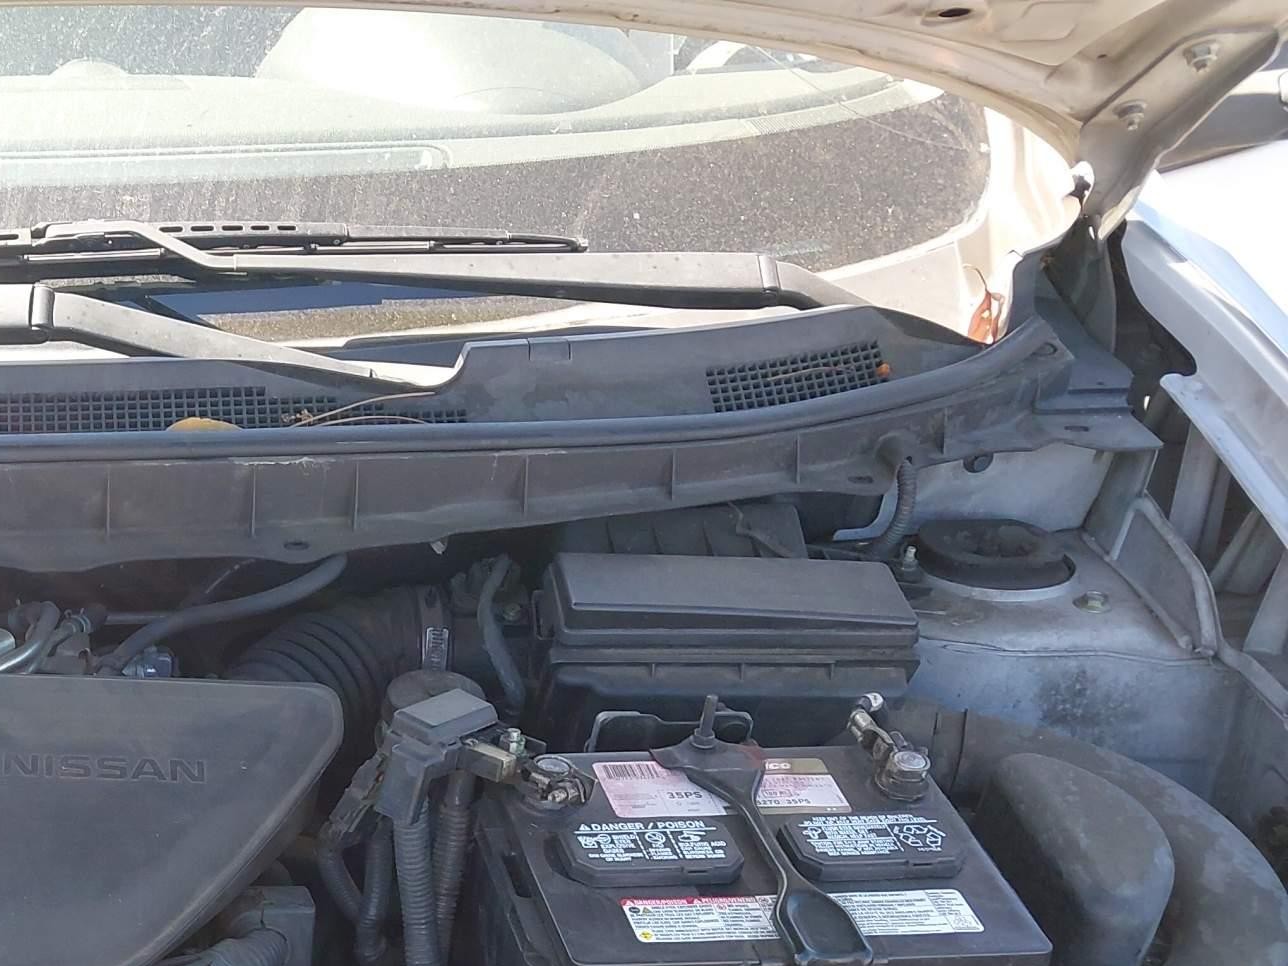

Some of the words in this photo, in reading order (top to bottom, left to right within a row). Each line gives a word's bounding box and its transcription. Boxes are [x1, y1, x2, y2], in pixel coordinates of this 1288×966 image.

[3, 752, 207, 784] NISSAN
[667, 791, 703, 799] 35PS
[591, 822, 644, 830] DANGER
[657, 820, 705, 829] POISON
